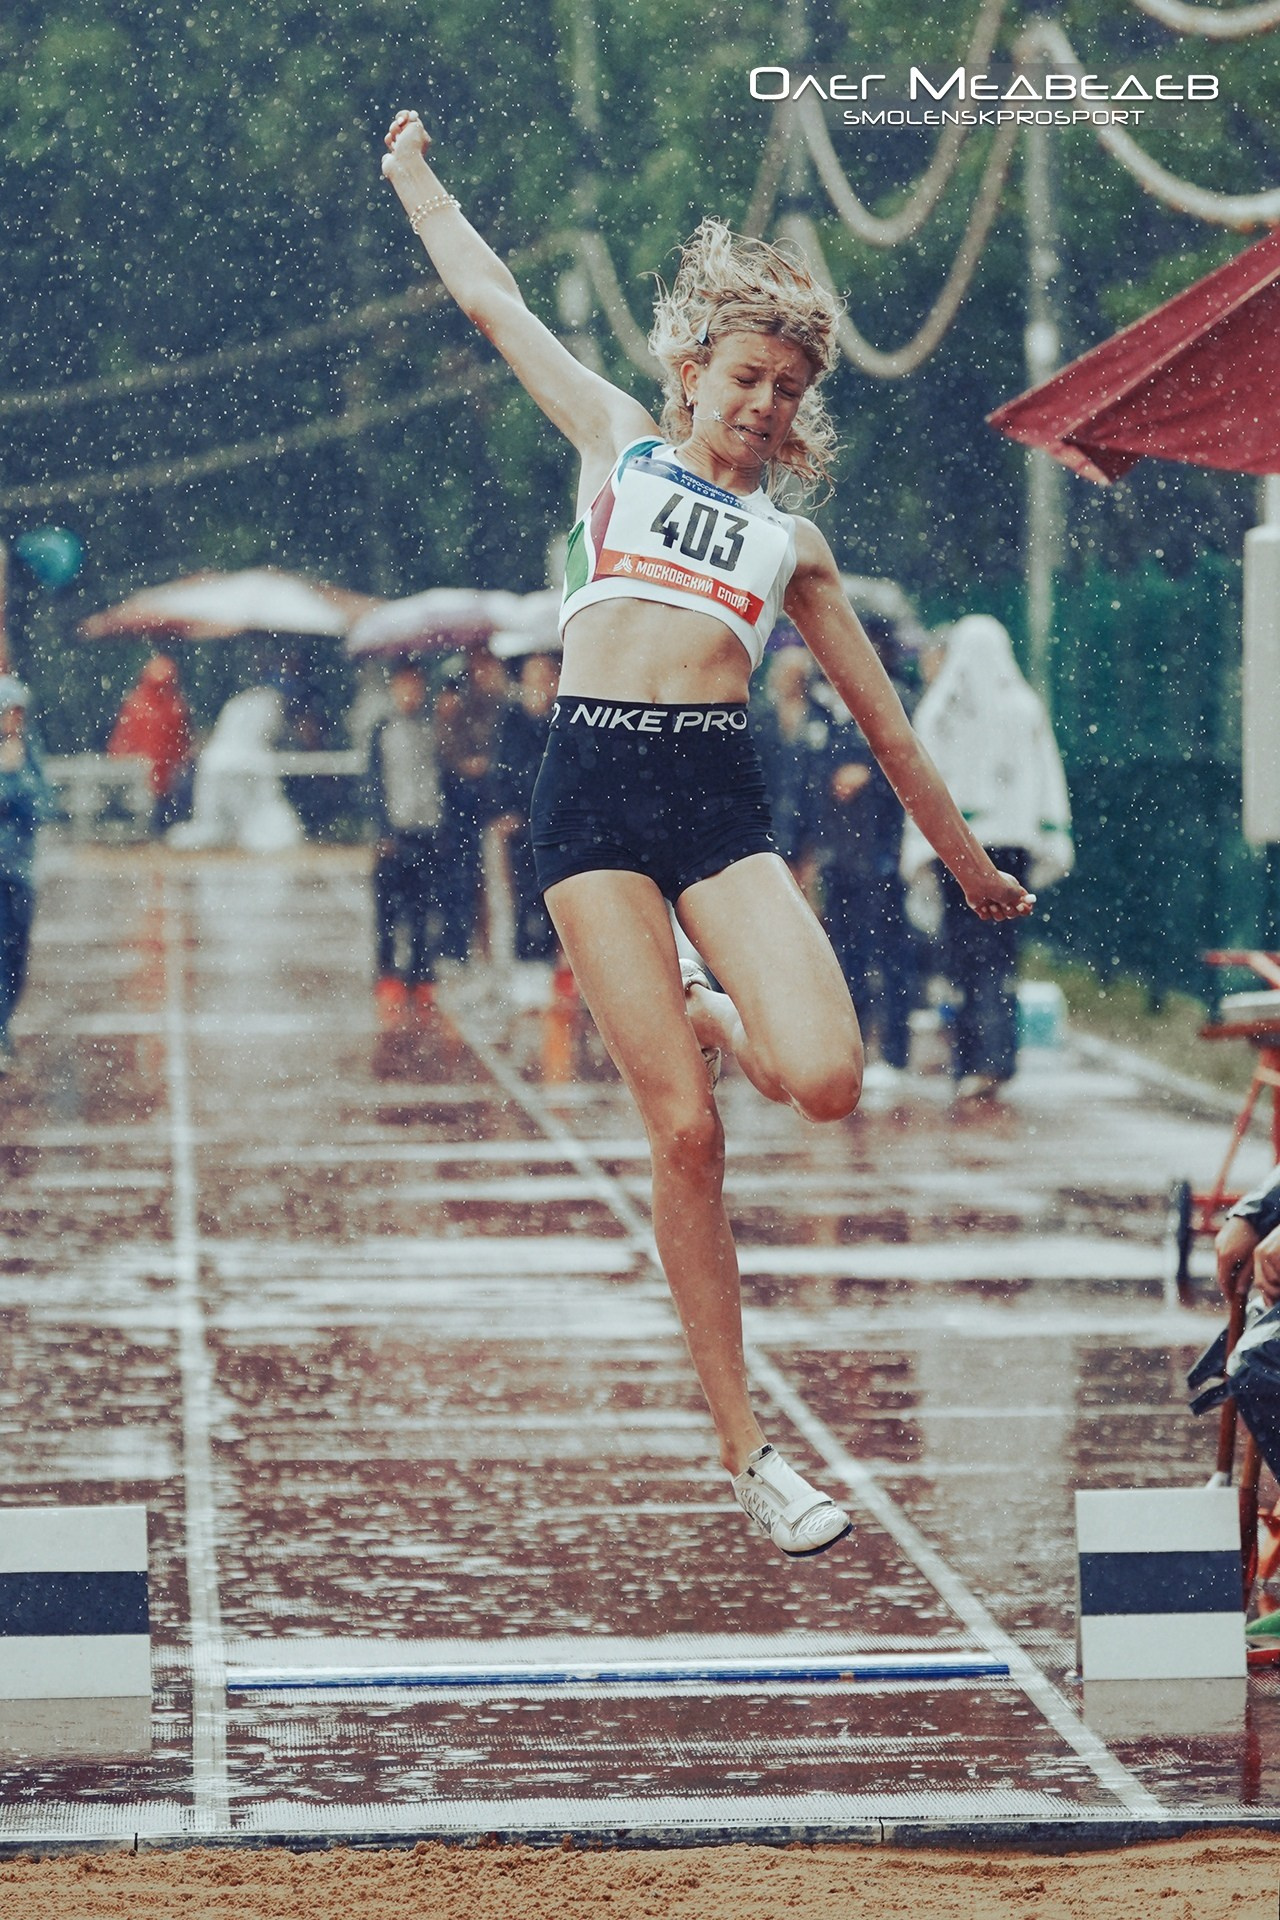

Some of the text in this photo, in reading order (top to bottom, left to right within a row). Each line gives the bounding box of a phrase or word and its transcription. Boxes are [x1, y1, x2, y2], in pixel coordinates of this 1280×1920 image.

[650, 493, 749, 572] 403
[635, 560, 751, 612] МОСКОВСКИЙ СПОРТ
[570, 704, 668, 733] NIKE
[673, 710, 748, 733] PRO
